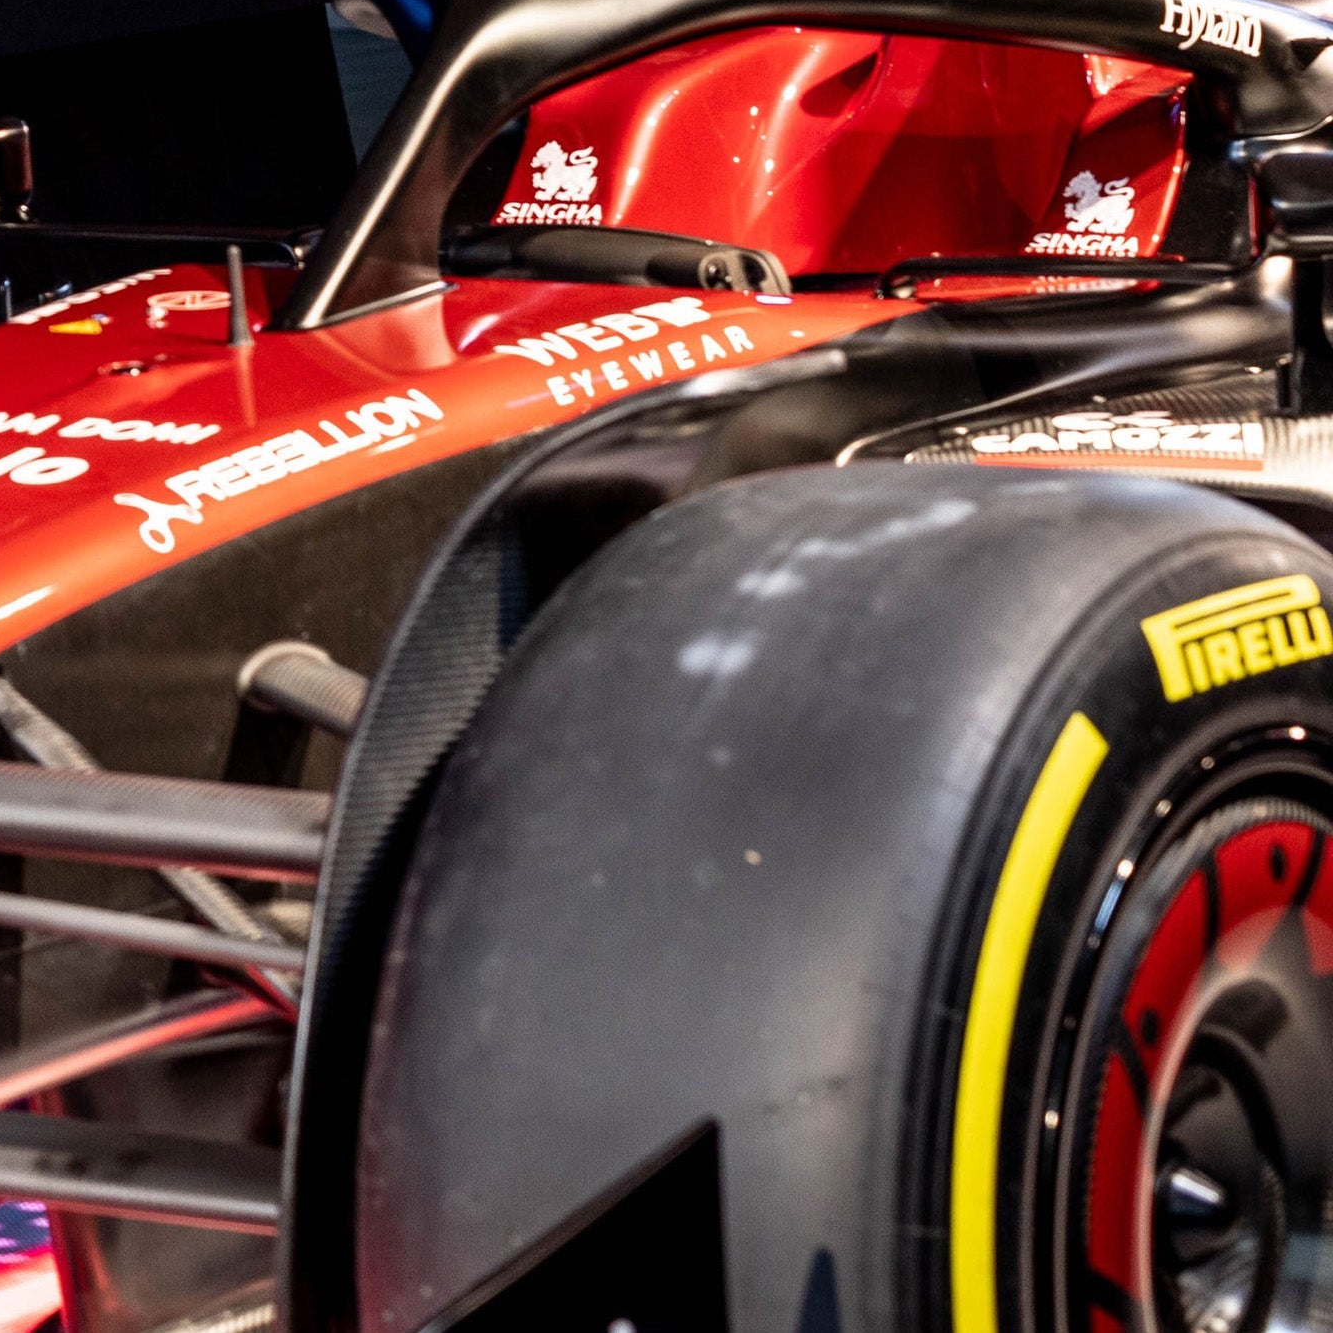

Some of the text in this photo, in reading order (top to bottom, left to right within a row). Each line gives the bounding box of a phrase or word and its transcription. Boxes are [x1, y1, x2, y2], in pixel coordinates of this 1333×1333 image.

[499, 202, 603, 222] SINGHA
[1028, 232, 1139, 254] SINGHA
[495, 309, 661, 367] WEB
[546, 325, 754, 407] EYEWEAR
[57, 417, 221, 444] DOMI
[165, 388, 445, 510] REBELLION
[971, 422, 1264, 454] CAMOZZI
[1140, 573, 1333, 704] PIRELLI
